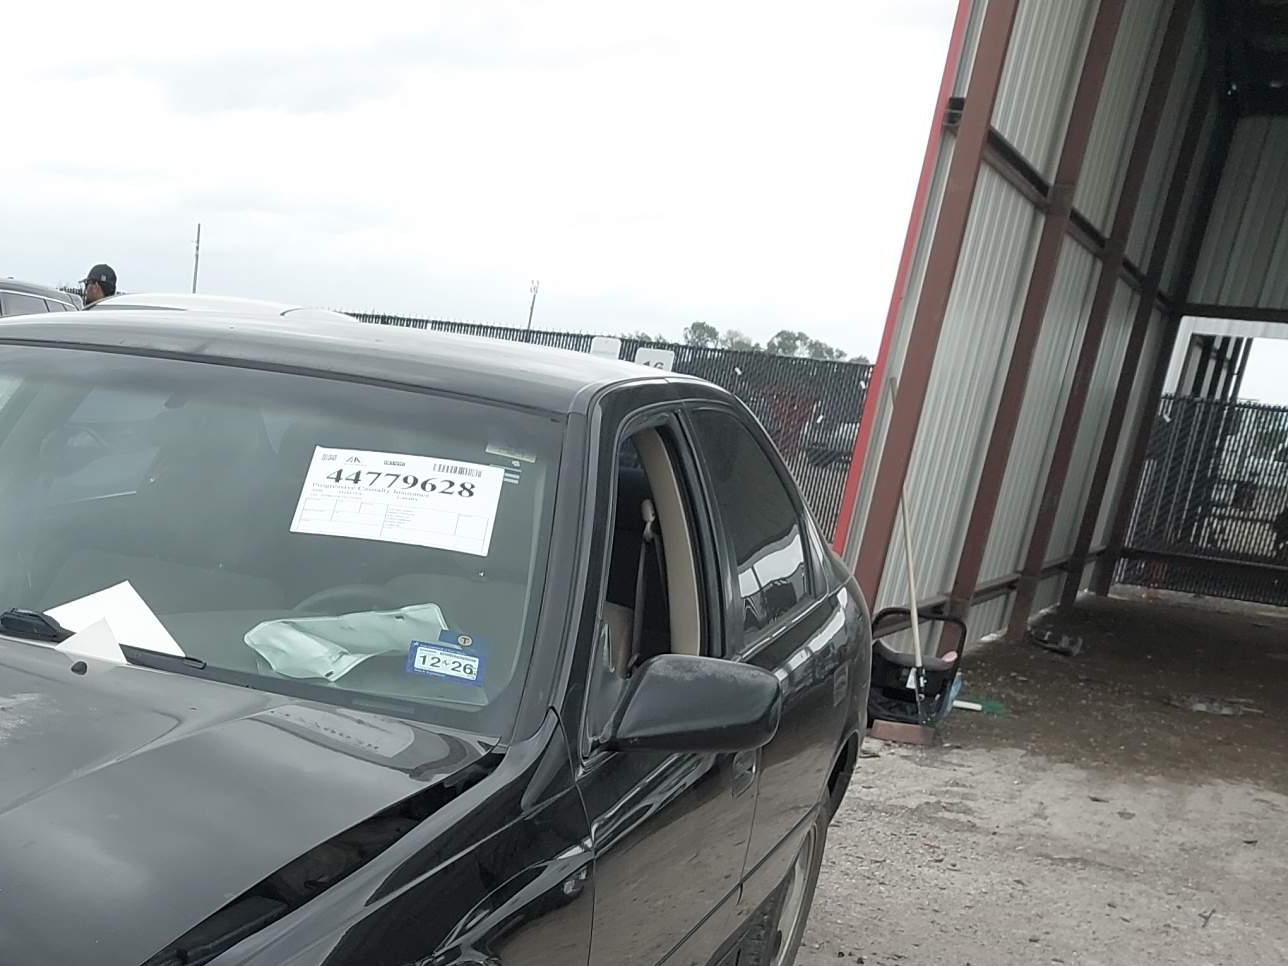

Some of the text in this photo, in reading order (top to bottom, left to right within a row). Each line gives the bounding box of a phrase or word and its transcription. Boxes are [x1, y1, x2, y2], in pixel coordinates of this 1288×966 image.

[325, 467, 477, 498] 44779628
[419, 655, 441, 668] 12
[451, 660, 474, 675] 26
